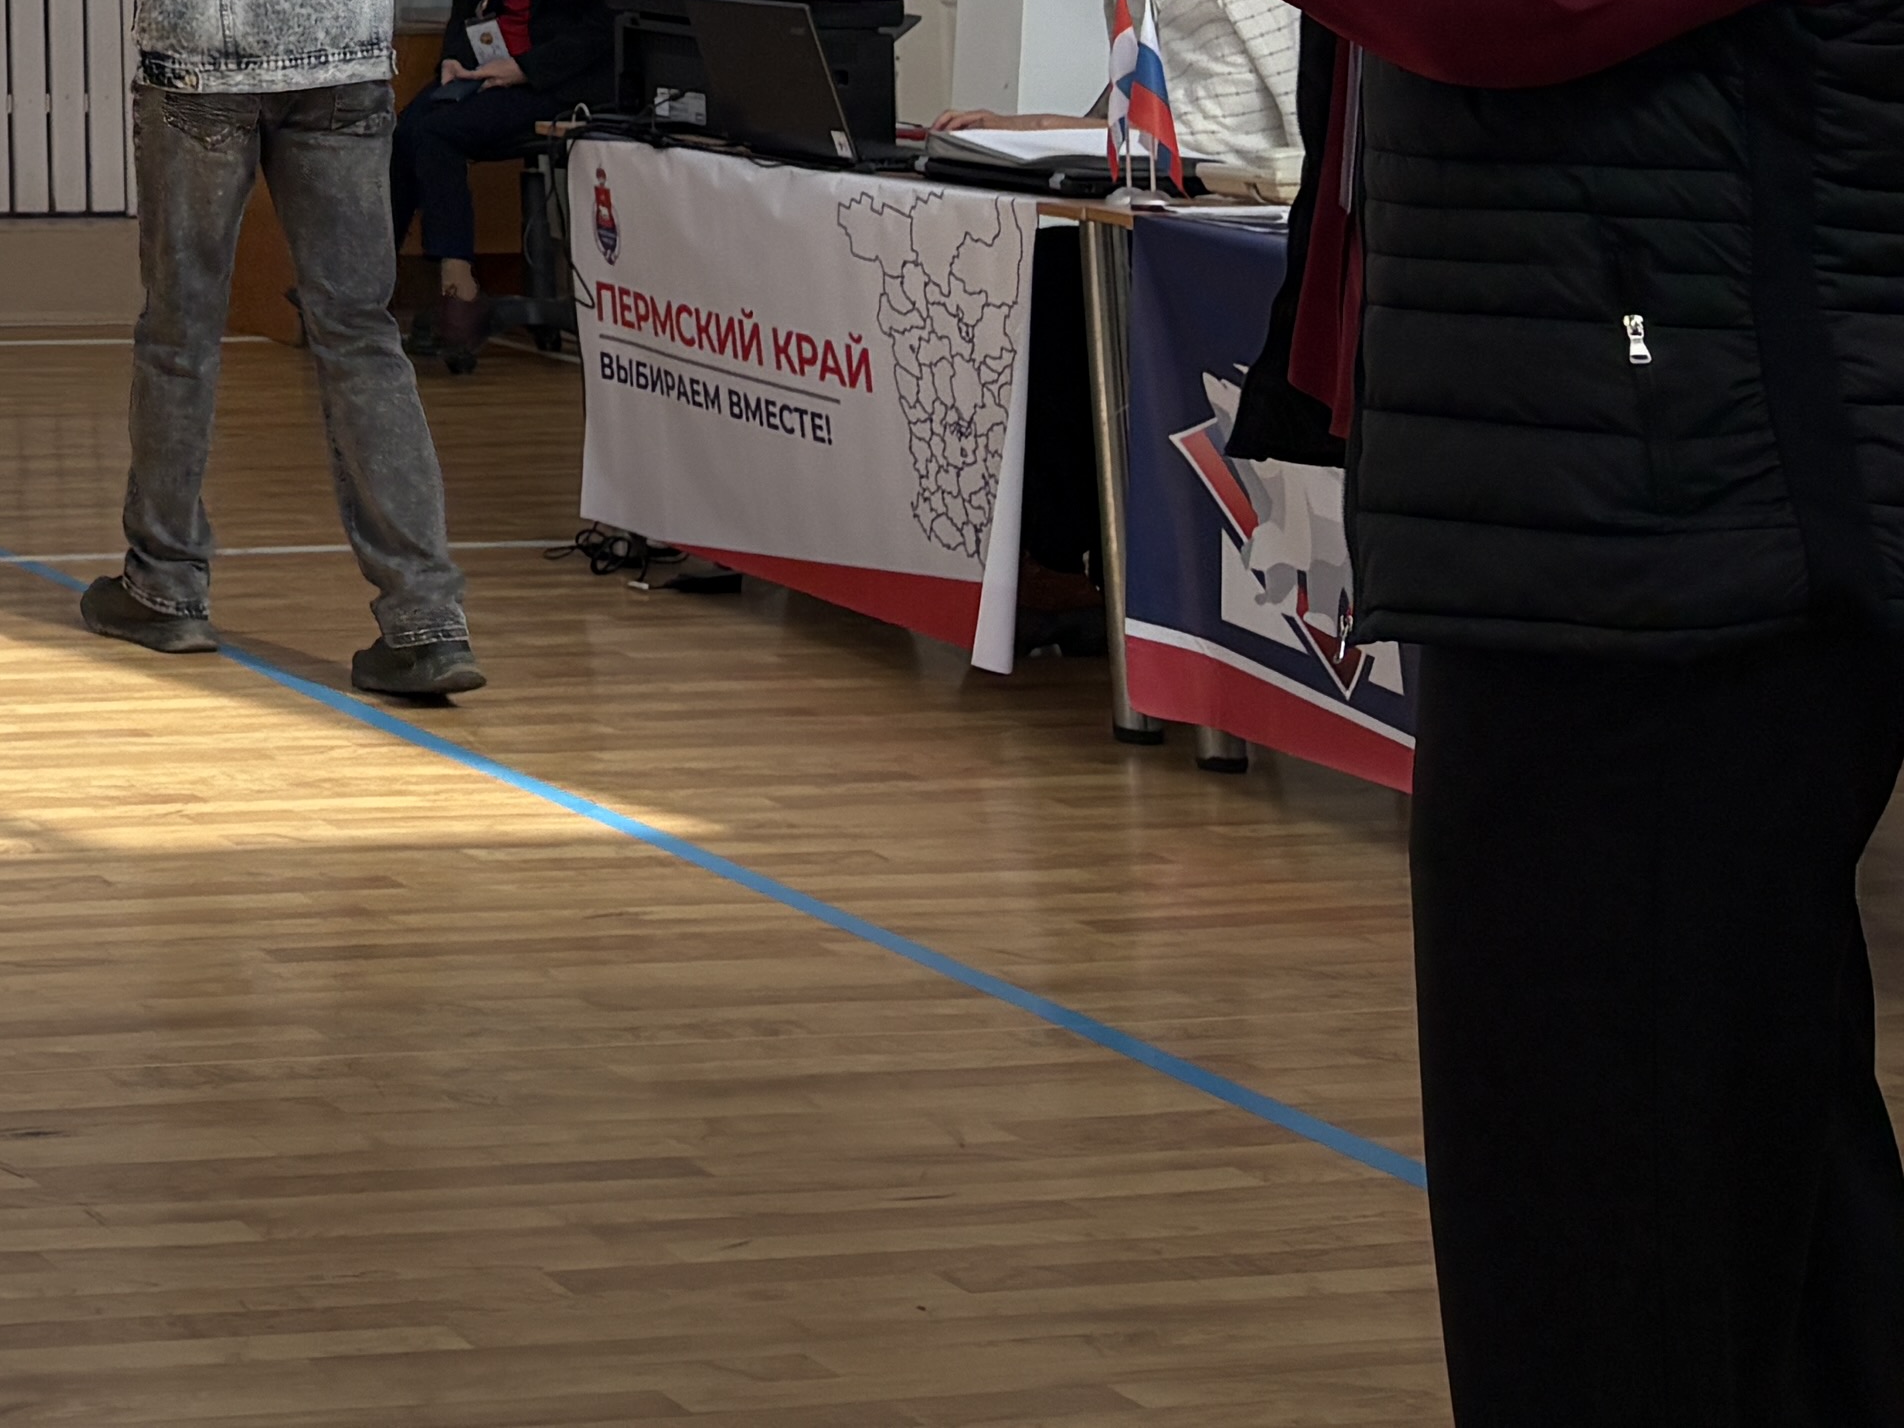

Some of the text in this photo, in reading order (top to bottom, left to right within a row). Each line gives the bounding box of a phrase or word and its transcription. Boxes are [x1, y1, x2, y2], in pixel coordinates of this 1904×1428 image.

[595, 280, 873, 394] ПЕРМСКИЙ КРАЙ
[599, 351, 833, 446] ВЫБИРАЕМ ВМЕСТЕ!
